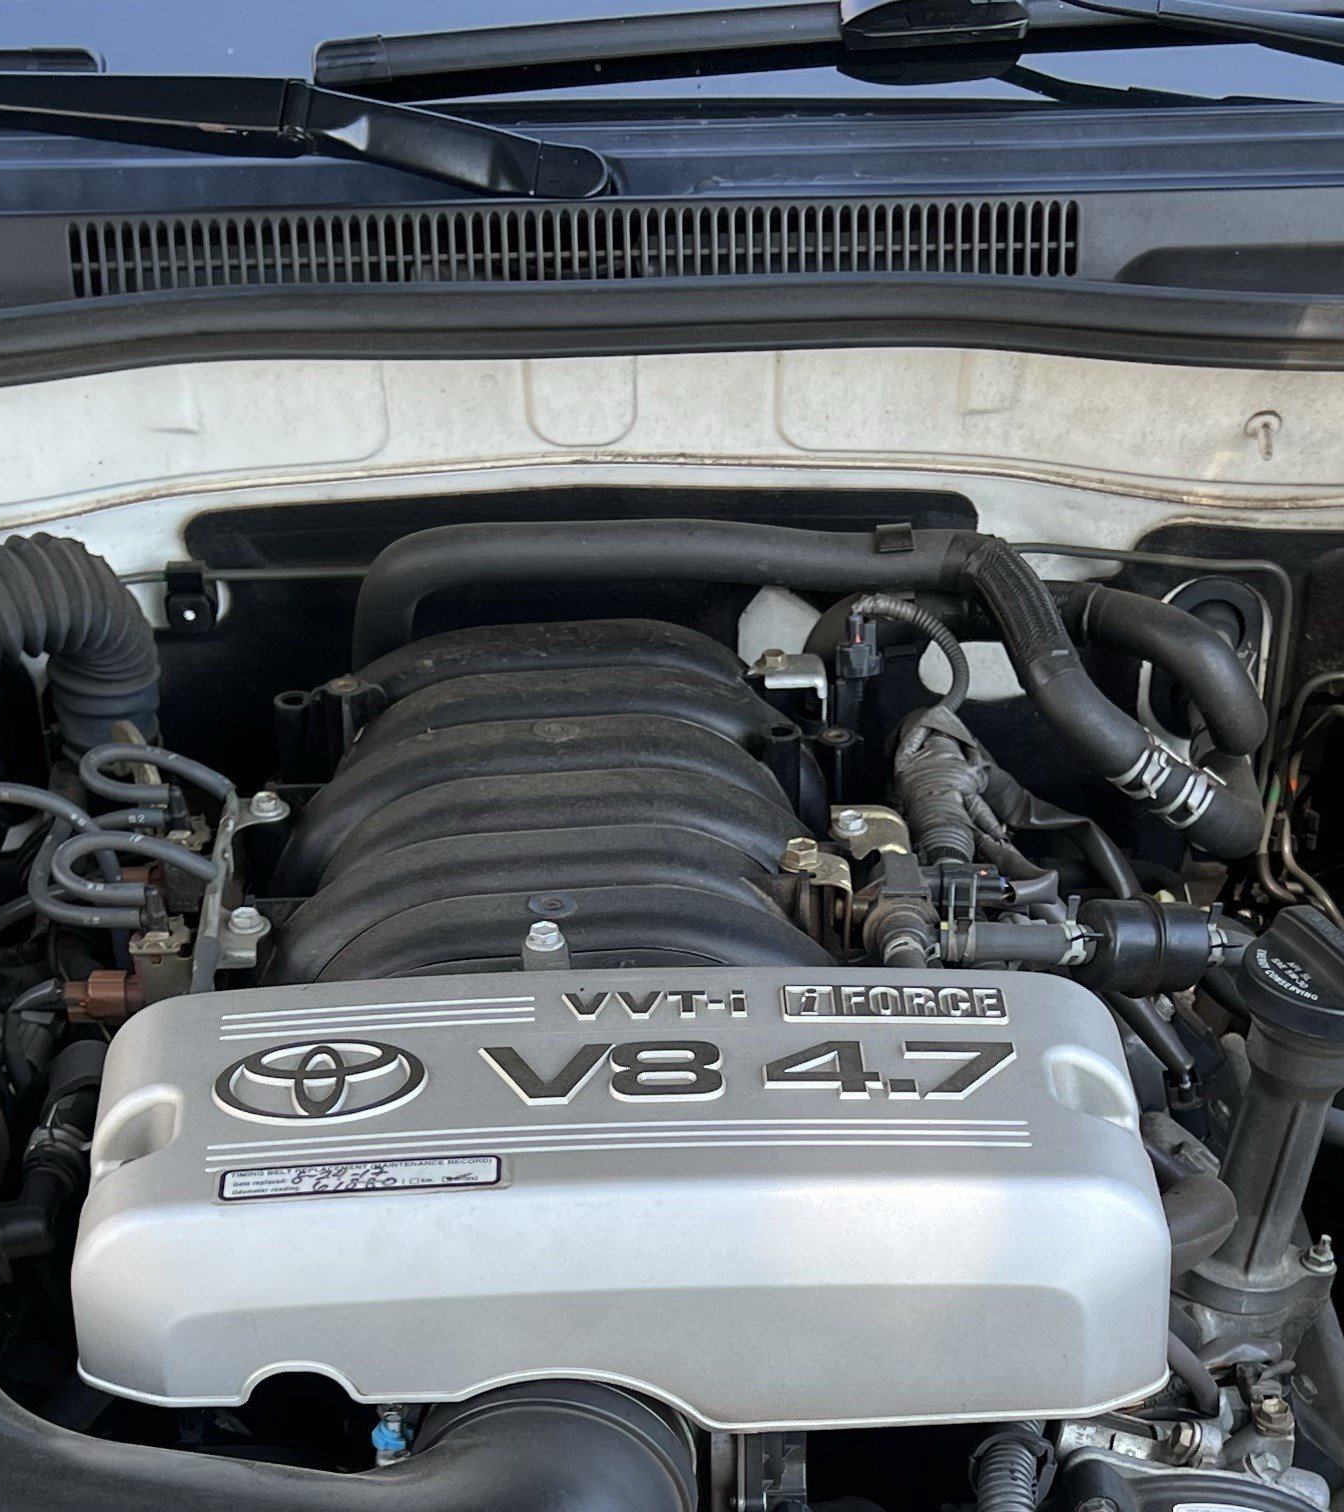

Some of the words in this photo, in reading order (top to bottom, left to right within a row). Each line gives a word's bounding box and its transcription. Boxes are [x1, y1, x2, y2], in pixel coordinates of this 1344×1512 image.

[1264, 969, 1319, 1001] CONSERVING
[562, 989, 748, 1020] VVT-i
[478, 1040, 727, 1106] V8
[762, 1040, 1018, 1101] 4.7
[231, 1171, 264, 1179] TIMING
[267, 1168, 290, 1176] BELT
[447, 1157, 492, 1165] RECORD)
